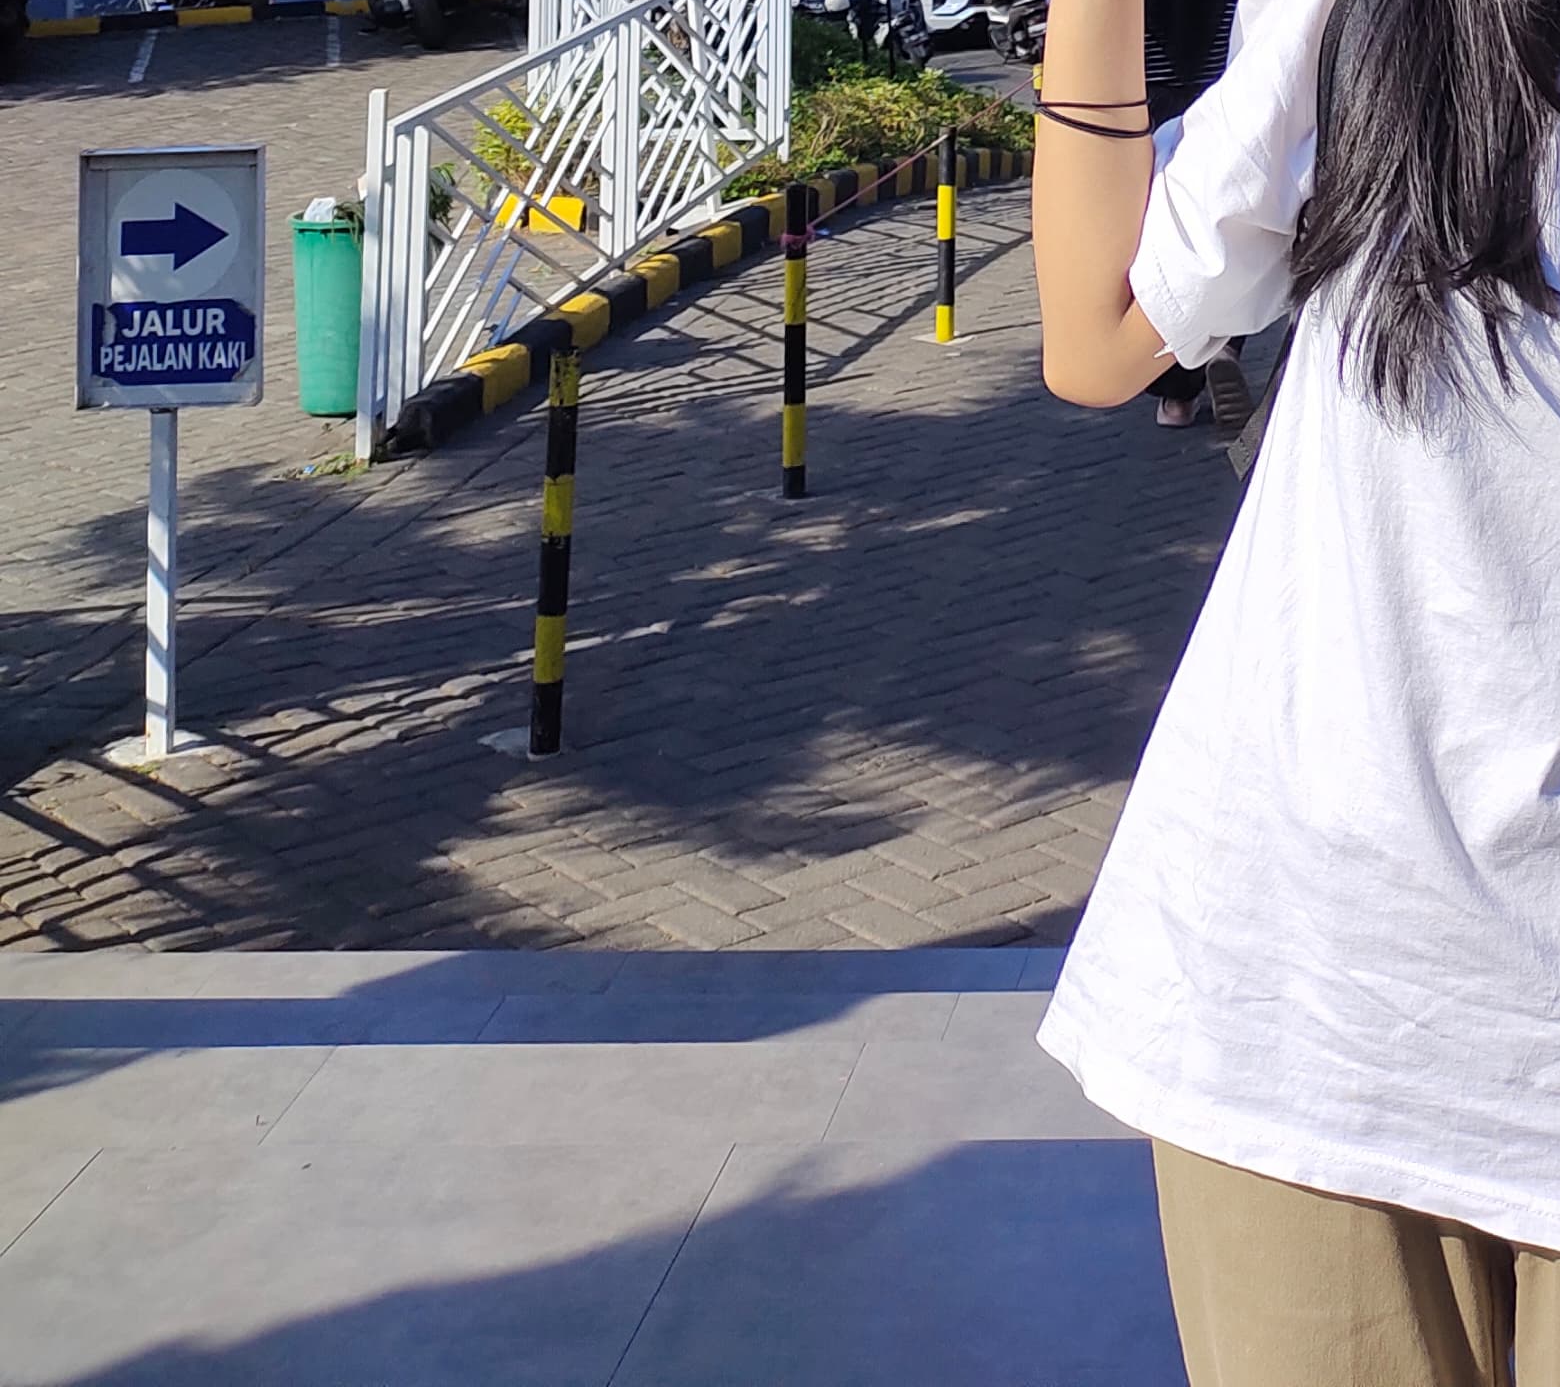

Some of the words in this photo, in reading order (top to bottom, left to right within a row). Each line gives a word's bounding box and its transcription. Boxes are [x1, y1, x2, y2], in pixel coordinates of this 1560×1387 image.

[121, 308, 226, 338] JALUR
[100, 342, 193, 373] PEJALAN
[198, 340, 246, 370] KAKI
